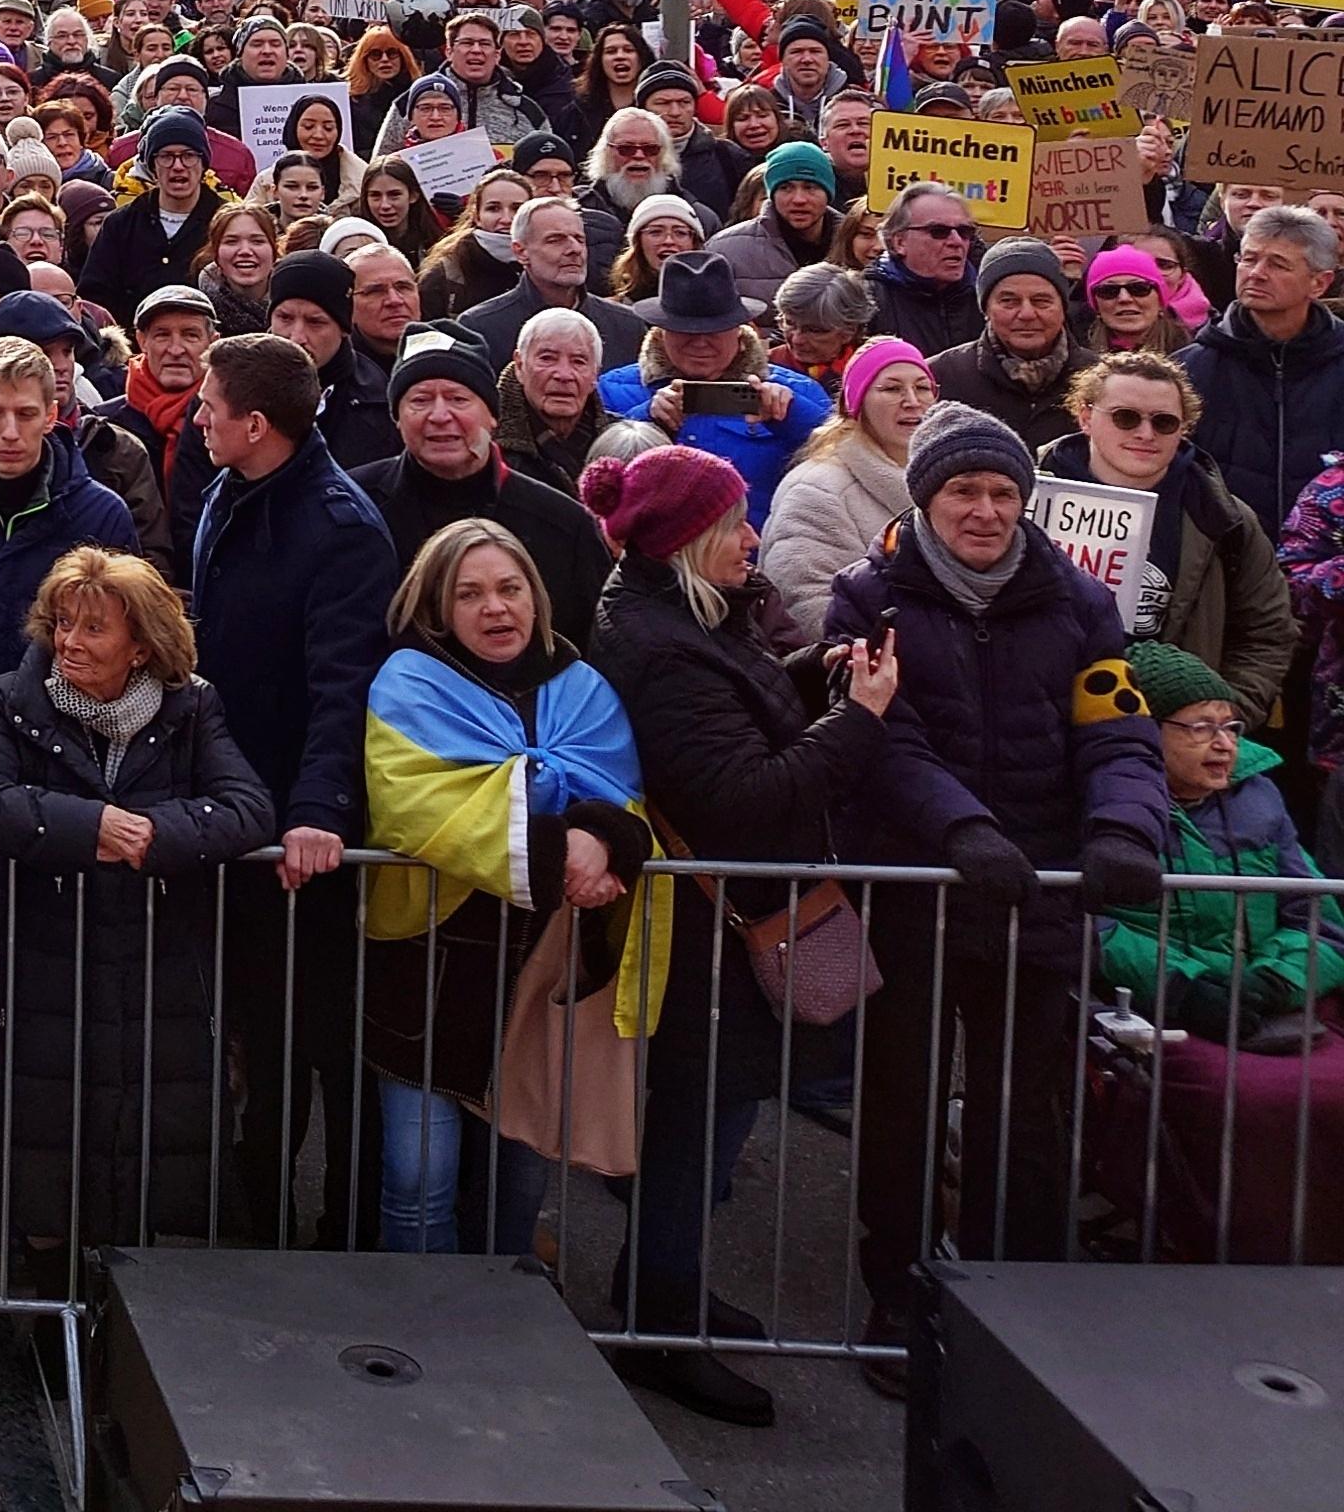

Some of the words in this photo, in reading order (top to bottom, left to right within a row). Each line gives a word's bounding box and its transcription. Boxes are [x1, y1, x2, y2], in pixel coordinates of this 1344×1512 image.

[868, 3, 987, 35] BUNT
[1018, 70, 1114, 96] München
[263, 104, 288, 112] Wenn
[1033, 106, 1060, 126] ist
[1062, 100, 1122, 125] bunt!
[1202, 98, 1325, 133] NIEMAND
[252, 127, 267, 135] die
[883, 127, 1019, 163] München
[1207, 140, 1256, 169] dein
[1074, 183, 1091, 195] als
